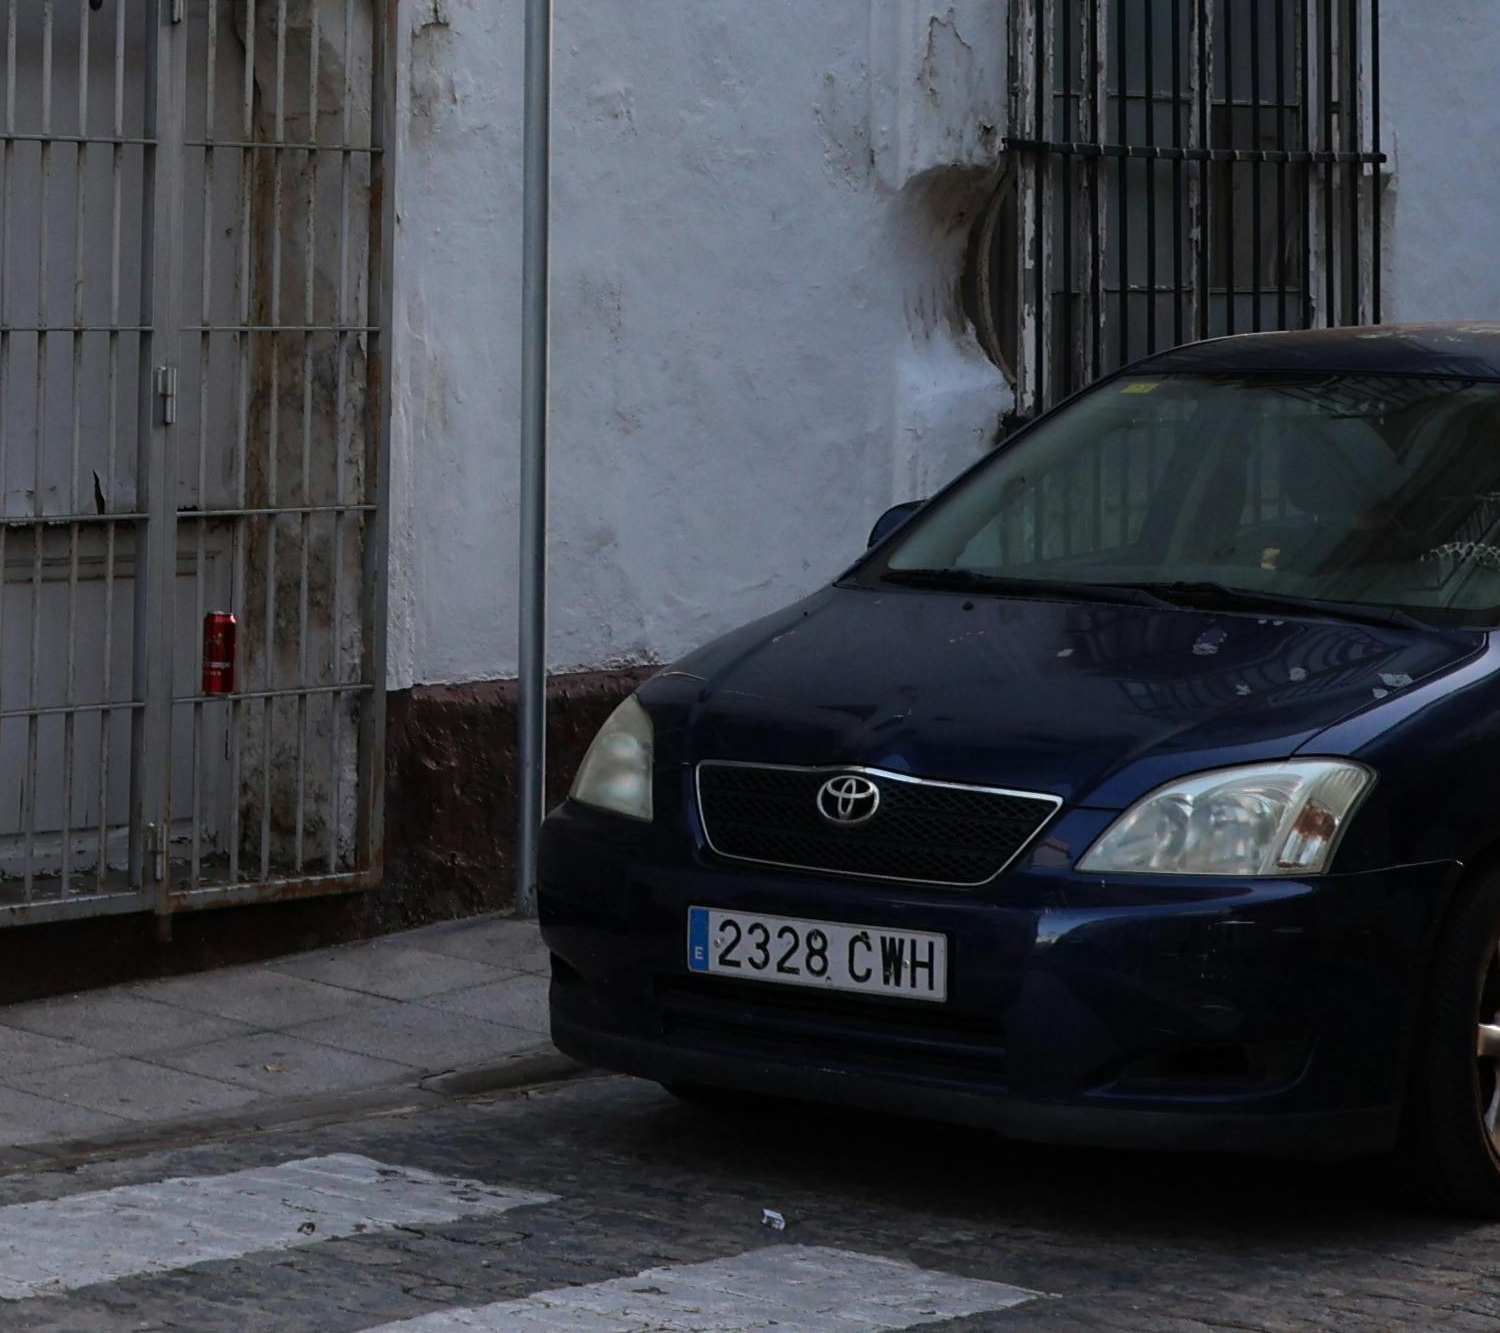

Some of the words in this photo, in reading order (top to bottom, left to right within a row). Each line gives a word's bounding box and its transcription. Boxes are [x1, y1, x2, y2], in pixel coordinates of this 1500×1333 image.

[694, 946, 704, 960] E
[719, 919, 829, 978] 2328
[848, 931, 935, 991] CWH
